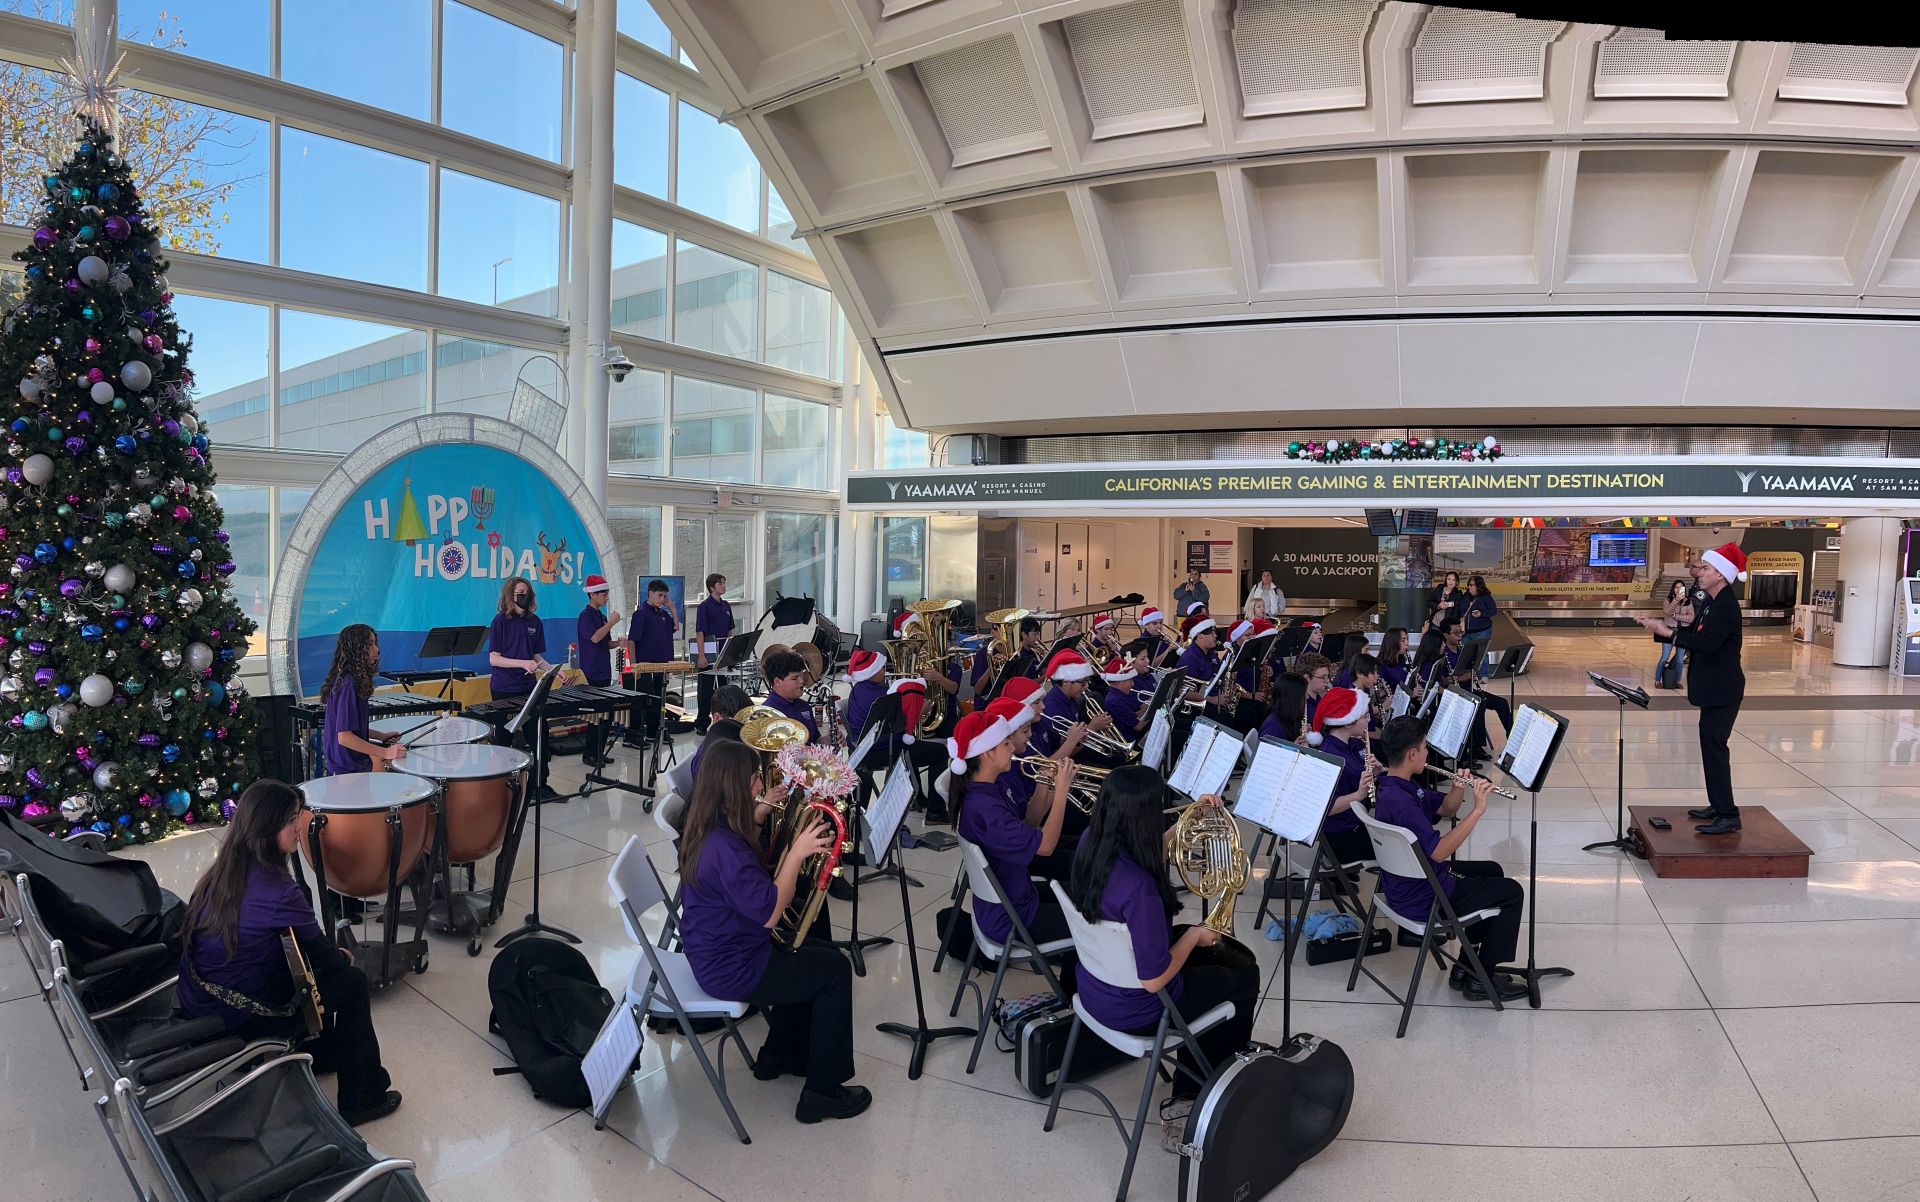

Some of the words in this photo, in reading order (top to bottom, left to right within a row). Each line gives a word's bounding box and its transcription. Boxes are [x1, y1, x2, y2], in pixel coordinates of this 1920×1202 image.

[1104, 477, 1212, 492] CALIFORNIA'S
[1218, 476, 1292, 491] PREMIER
[1297, 475, 1368, 490] GAMING
[1373, 475, 1386, 489] &
[1392, 474, 1541, 489] ENTERTAINMENT
[1547, 473, 1664, 488] DESTINATION
[1272, 553, 1281, 562] A
[1283, 553, 1297, 563] 30
[1299, 553, 1344, 563] MINUTE
[1294, 566, 1309, 576] TO
[1311, 566, 1320, 576] A
[1322, 566, 1374, 576] JACKPOT
